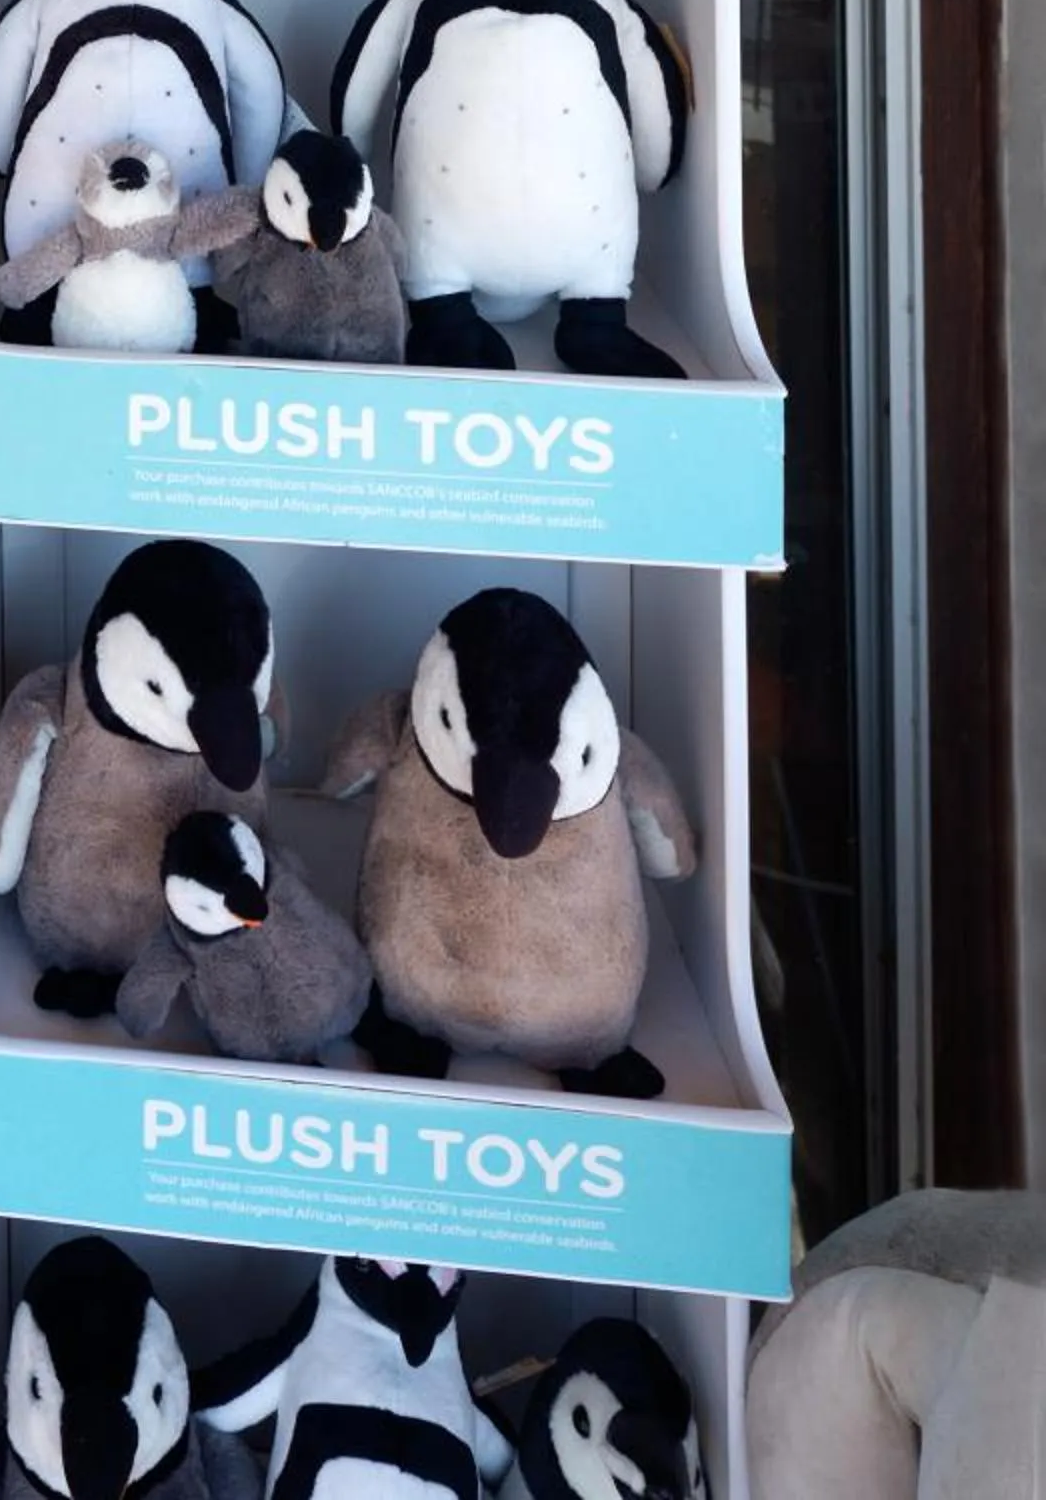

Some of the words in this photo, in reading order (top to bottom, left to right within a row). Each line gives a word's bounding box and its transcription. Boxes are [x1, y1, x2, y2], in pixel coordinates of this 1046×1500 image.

[128, 393, 375, 461] PLUSH
[405, 409, 615, 473] TOYS
[142, 1098, 388, 1176] PLUSH
[419, 1128, 624, 1199] TOYS
